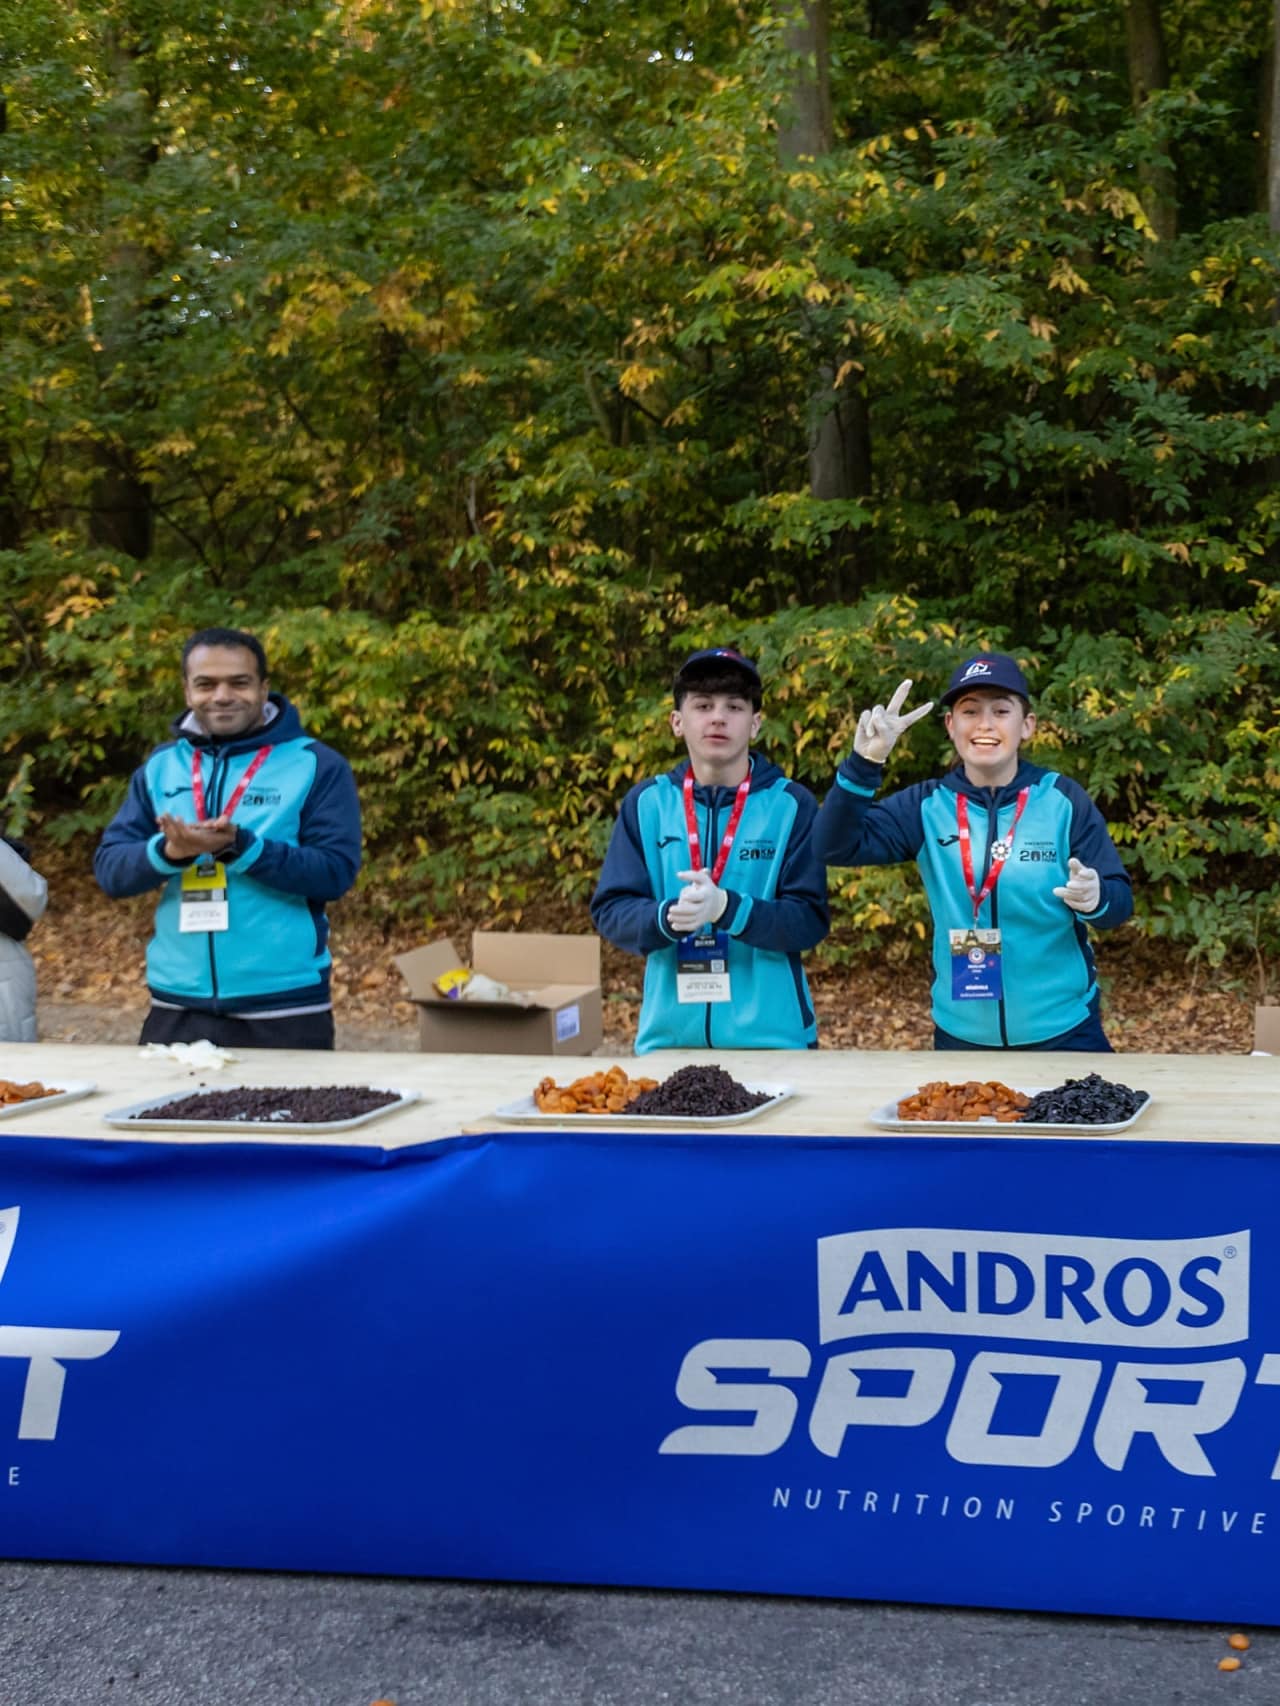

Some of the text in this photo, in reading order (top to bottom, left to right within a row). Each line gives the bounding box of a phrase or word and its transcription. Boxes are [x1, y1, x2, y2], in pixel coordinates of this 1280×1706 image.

[838, 1250, 1226, 1328] ANDROS
[773, 1487, 1267, 1535] NUTRITION SPORTIVE
